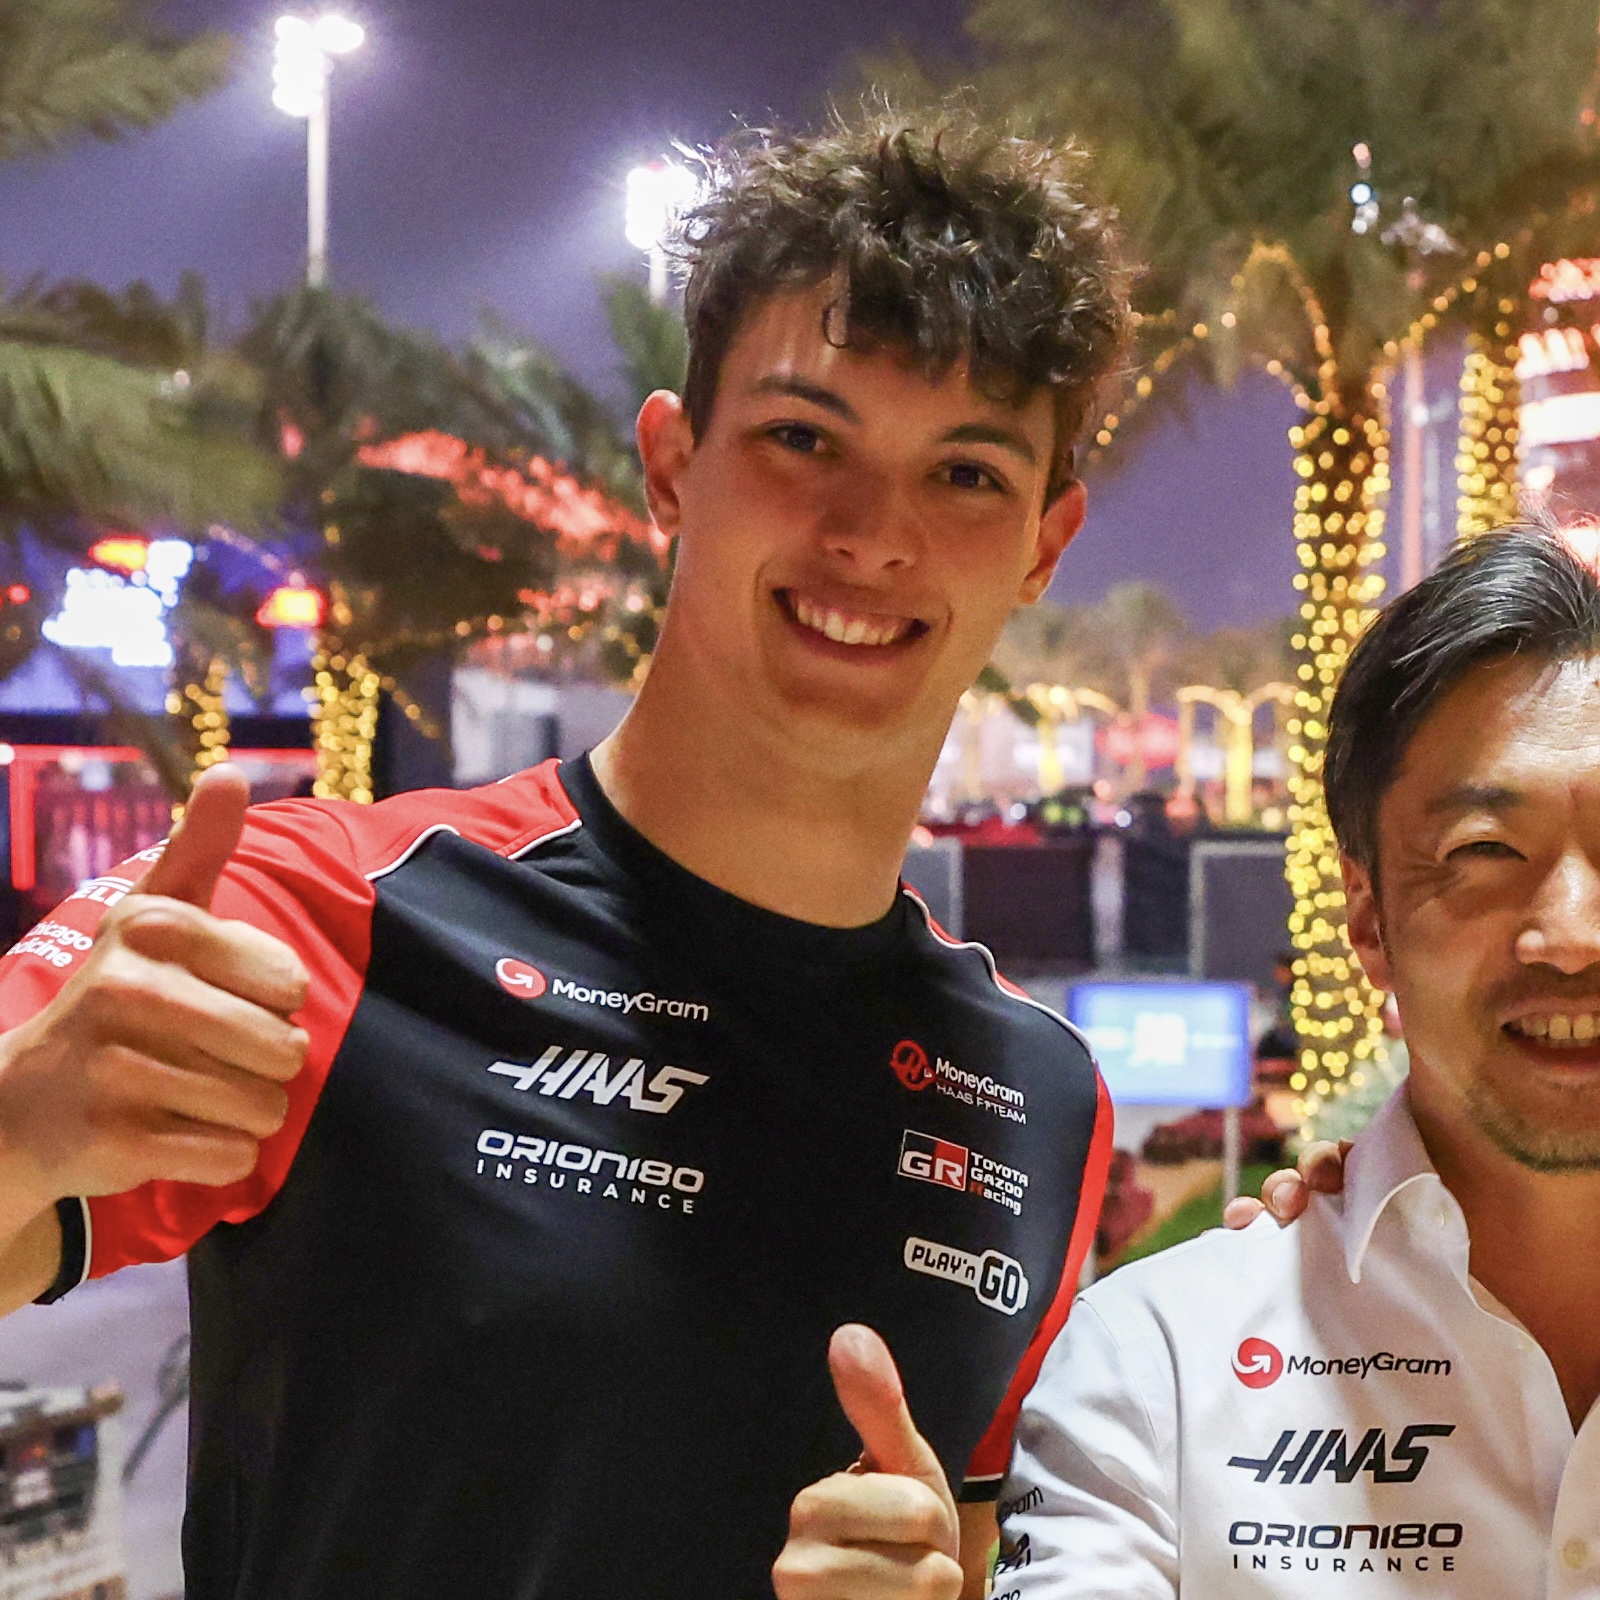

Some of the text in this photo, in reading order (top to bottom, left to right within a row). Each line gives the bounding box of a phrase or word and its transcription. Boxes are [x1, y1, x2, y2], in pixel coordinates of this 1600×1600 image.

[552, 978, 709, 1022] MoneyGram
[486, 1045, 711, 1114] HAAS
[935, 1057, 1025, 1107] MoneyGram
[936, 1083, 974, 1105] HAAS
[991, 1102, 1028, 1125] TEAM
[476, 1129, 705, 1193] ORION180
[902, 1150, 963, 1187] GR
[970, 1151, 1029, 1187] TOYOTA
[476, 1158, 694, 1214] INSURANCE
[969, 1181, 1022, 1216] Racing
[970, 1167, 1023, 1199] GAZOO
[979, 1255, 1021, 1309] GO
[1286, 1352, 1452, 1380] MoneyGram
[1226, 1424, 1457, 1484] HAAS
[1228, 1521, 1464, 1550] ORION180
[1232, 1554, 1456, 1573] INSURANCE
